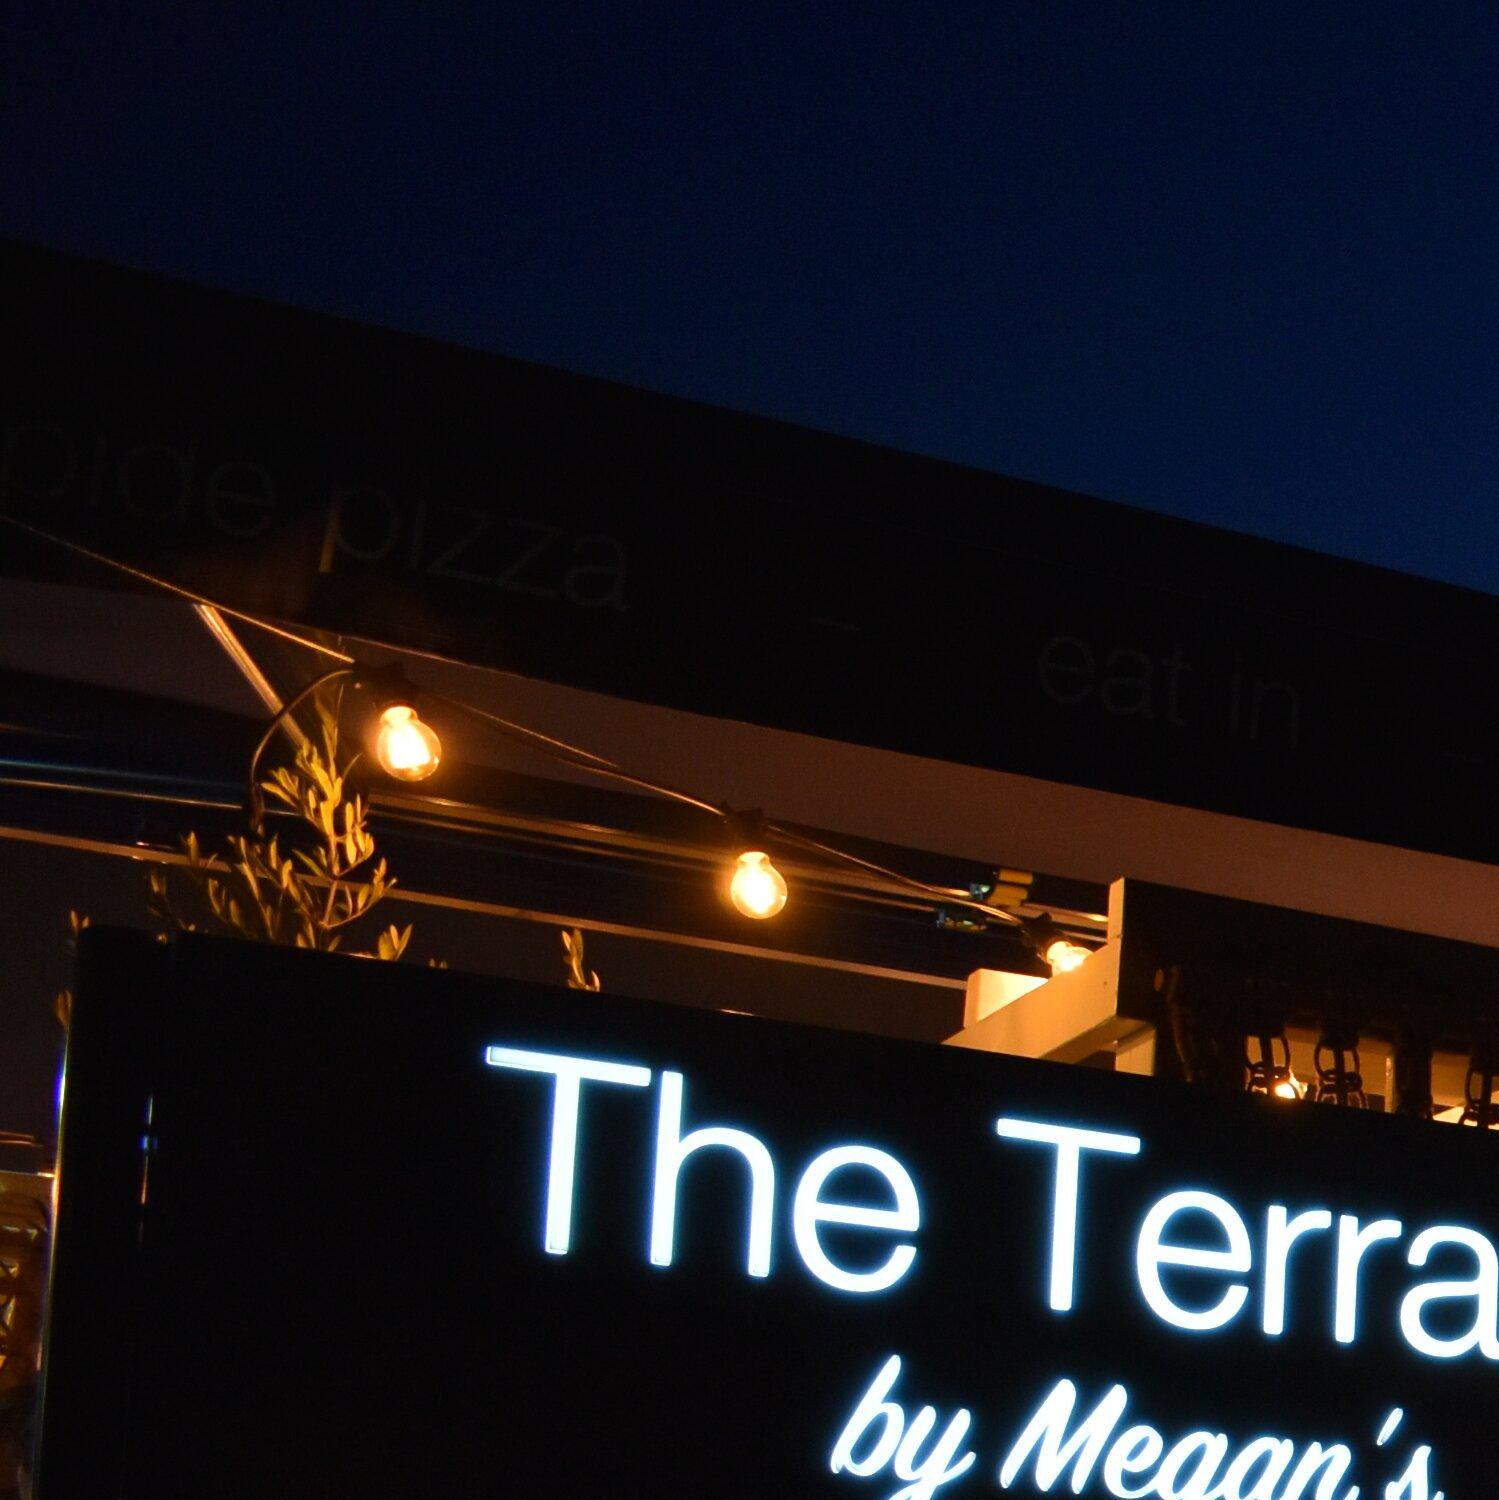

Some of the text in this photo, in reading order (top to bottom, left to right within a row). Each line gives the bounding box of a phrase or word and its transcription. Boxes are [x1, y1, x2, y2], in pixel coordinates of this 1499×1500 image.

[316, 480, 630, 614] pizza
[1036, 634, 1192, 727] eat
[1226, 648, 1300, 752] in
[485, 1046, 920, 1293] The
